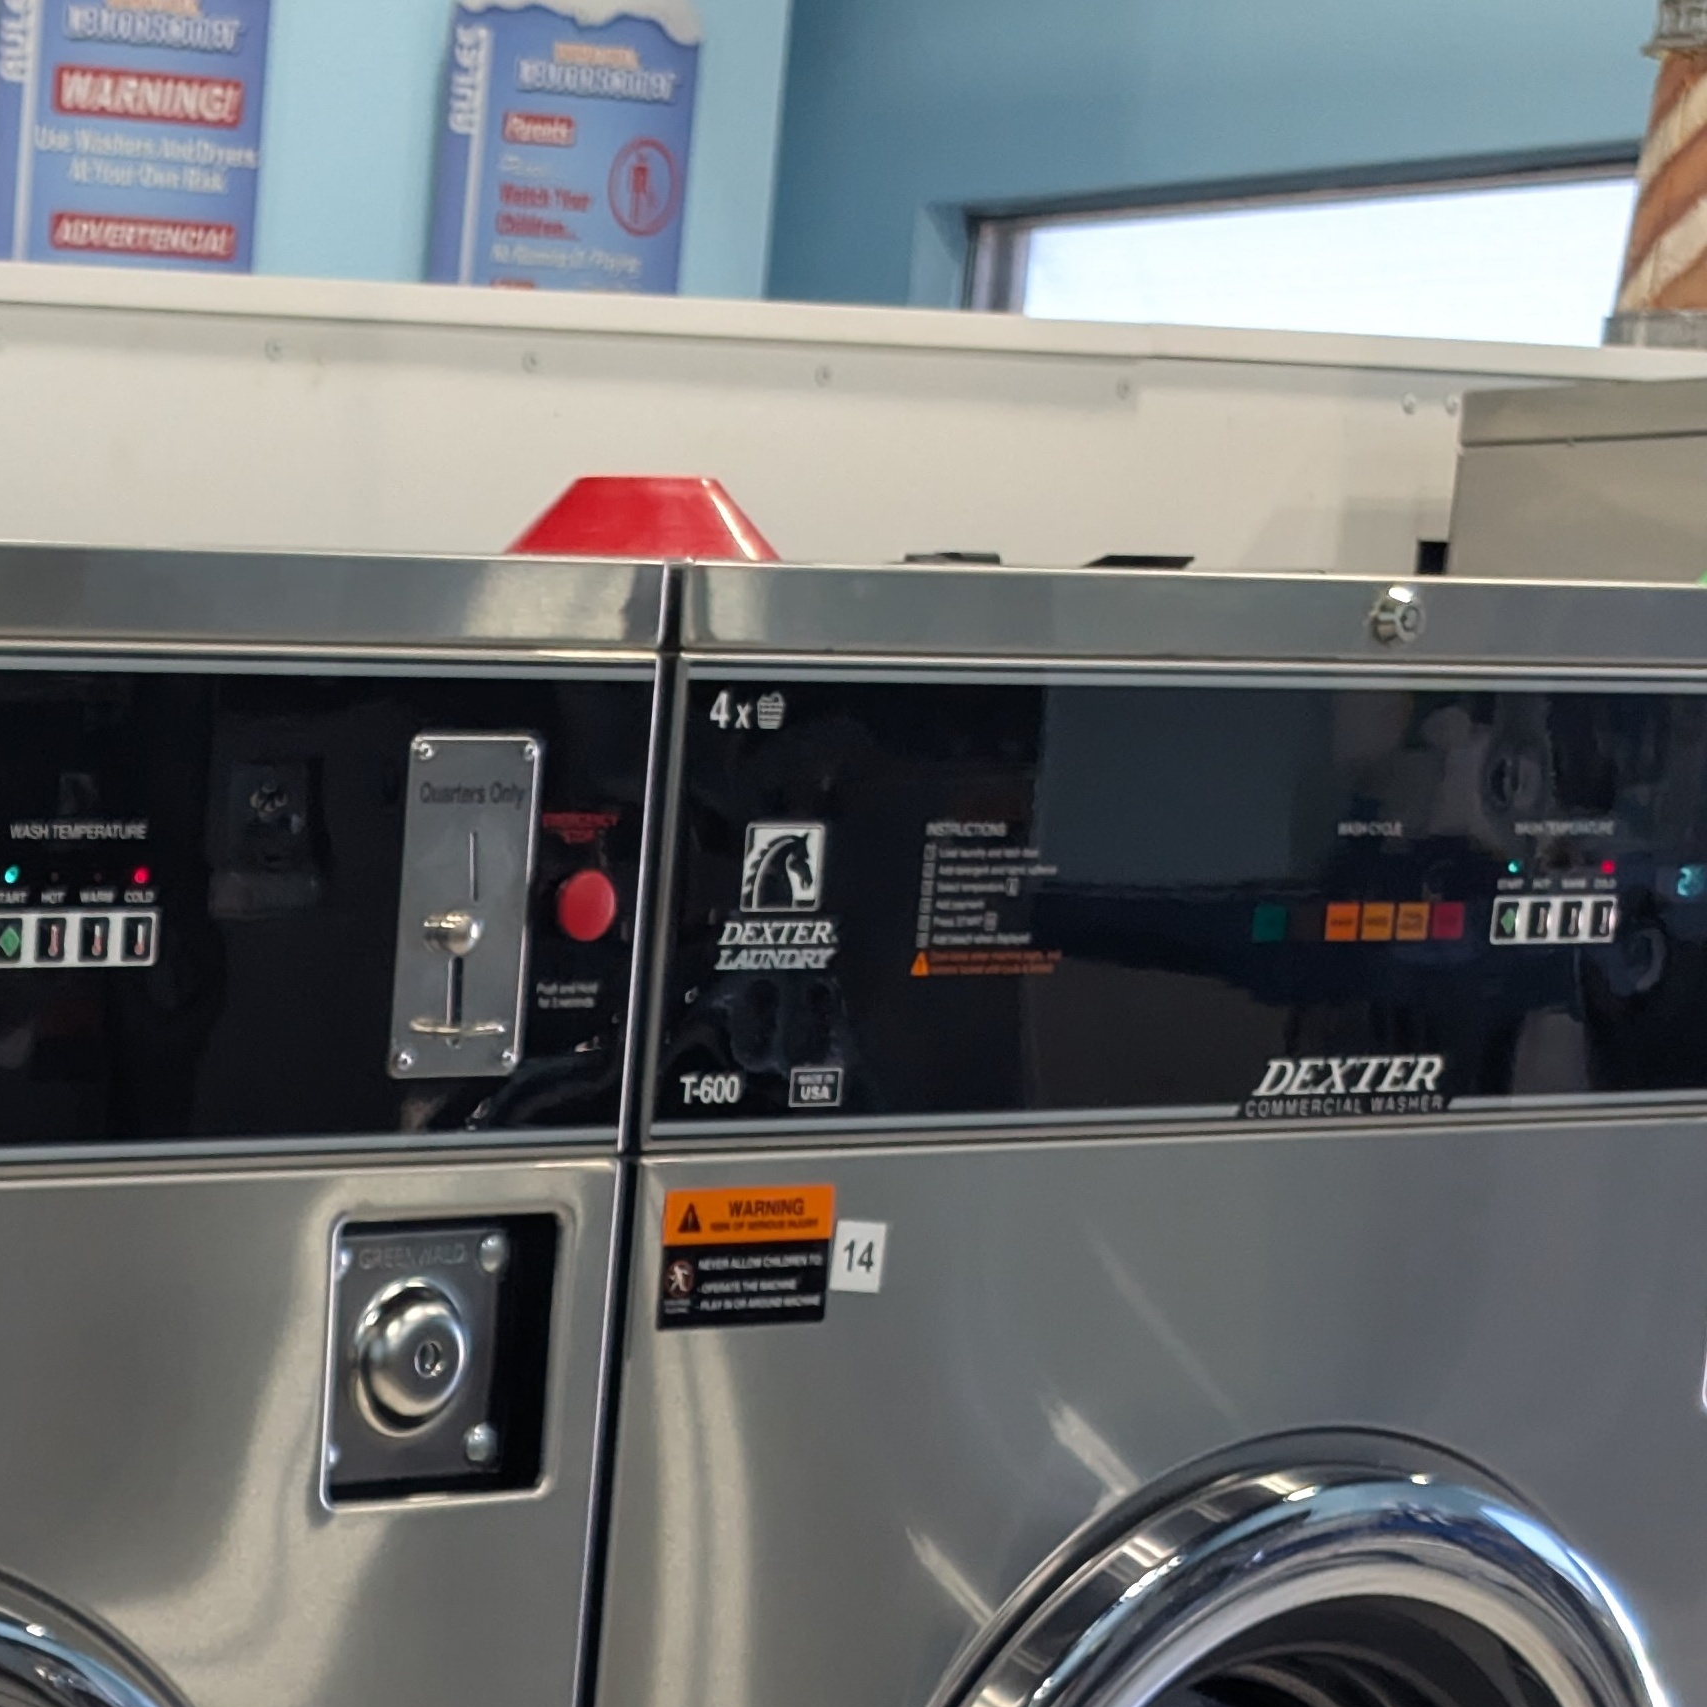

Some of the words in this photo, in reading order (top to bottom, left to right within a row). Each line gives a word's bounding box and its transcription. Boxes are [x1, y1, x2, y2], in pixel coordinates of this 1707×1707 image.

[61, 68, 240, 124] WARNING!
[420, 781, 485, 804] Quarters
[490, 781, 526, 810] Only
[10, 823, 49, 839] WASH
[53, 823, 147, 839] TEMPERATURE
[717, 921, 833, 945] DEXTER
[714, 948, 838, 971] LAUNDRY
[1251, 1055, 1444, 1096] DEXTER
[680, 1074, 741, 1104] T-600
[800, 1085, 830, 1100] USA
[1245, 1098, 1364, 1118] COMMERCIAL
[1371, 1094, 1443, 1113] WASHER
[728, 1198, 805, 1217] WARNING
[844, 1239, 874, 1273] 14
